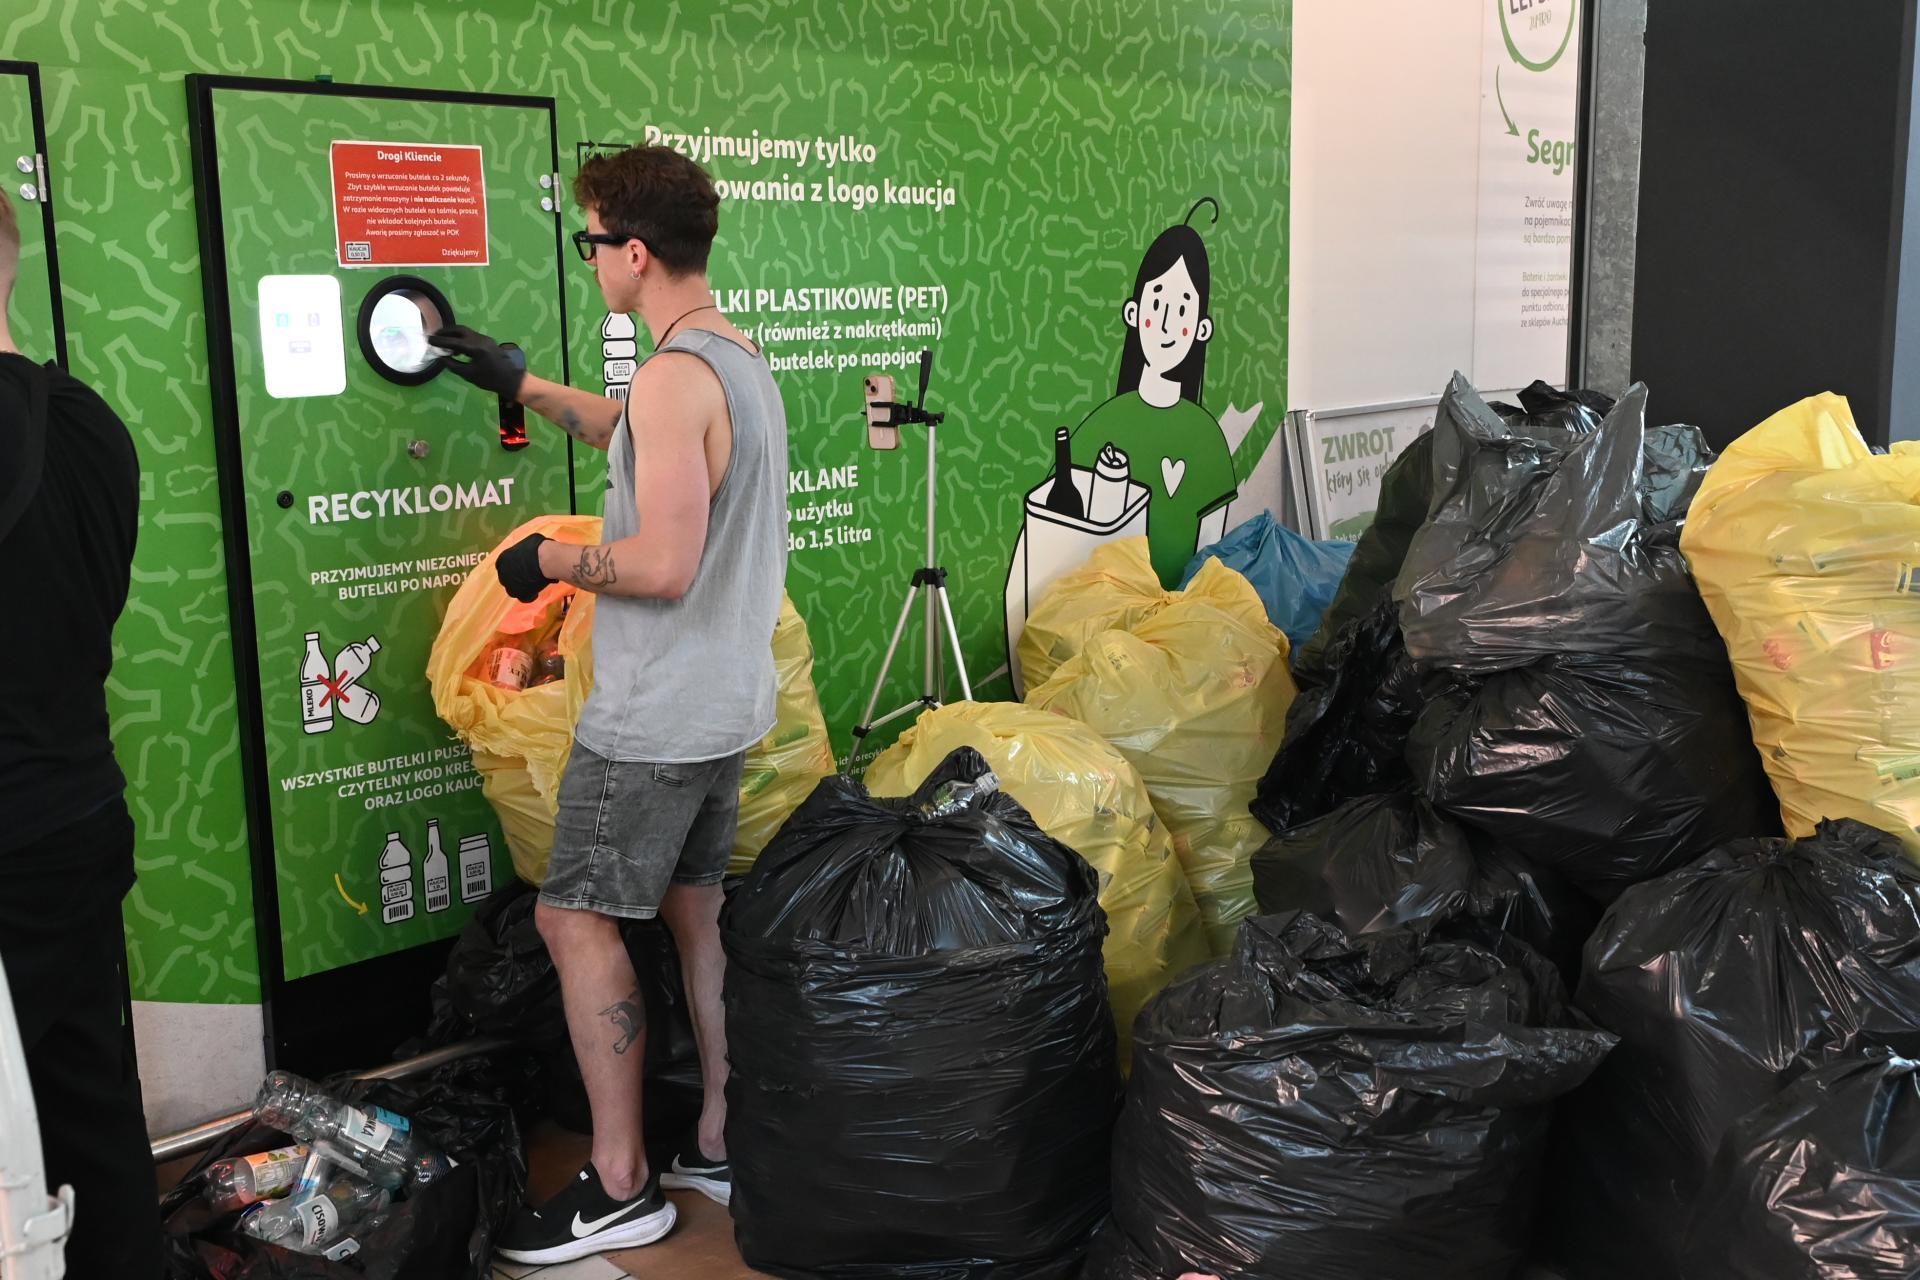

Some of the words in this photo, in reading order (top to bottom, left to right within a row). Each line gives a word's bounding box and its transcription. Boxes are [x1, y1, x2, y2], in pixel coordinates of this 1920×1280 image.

[377, 150, 403, 163] Drogi
[404, 151, 442, 162] Kliencie
[645, 125, 810, 168] Przyjmujemy
[815, 135, 876, 168] tylko
[345, 172, 370, 181] Prosimy
[408, 173, 431, 181] butelek
[347, 183, 362, 192] Zbyt
[363, 183, 386, 192] szybkie
[418, 184, 441, 192] butelek
[343, 195, 382, 204] zatrzymanie
[382, 196, 410, 204] maszyny
[712, 173, 805, 202] owania
[811, 183, 823, 202] z
[828, 176, 879, 211] logo
[884, 178, 956, 213] kaucja
[367, 207, 404, 215] widocznych
[404, 207, 427, 215] butelek
[404, 218, 433, 226] kolejnych
[366, 229, 388, 237] Awarię
[388, 229, 412, 237] prosimy
[442, 248, 480, 257] Dziękujemy
[709, 288, 750, 313] LKI
[755, 287, 893, 312] PLASTIKOWE
[897, 284, 948, 316] (PET)
[757, 320, 830, 347] (również
[833, 327, 842, 339] z
[845, 316, 942, 342] nakrętkami)
[770, 349, 834, 371] butelek
[838, 353, 858, 373] po
[861, 345, 928, 371] napojac
[1321, 426, 1396, 465] ZWROT
[786, 465, 858, 494] KLANE
[1325, 468, 1353, 502] który
[1357, 465, 1370, 487] się
[308, 477, 515, 524] RECYKLOMAT
[796, 498, 853, 525] użytku
[786, 532, 806, 552] do
[809, 528, 834, 551] 1,5
[837, 525, 872, 545] litra
[310, 560, 413, 586] PRZYJMUJEMY
[338, 580, 398, 601] BUTELKI
[400, 578, 420, 593] PO
[305, 688, 315, 718] MLEKO
[280, 763, 365, 792] WSZYSTKIE
[367, 752, 425, 775] BUTELKI
[427, 751, 433, 763] I
[338, 772, 411, 799] CZYTELNY
[414, 766, 442, 784] KOD
[364, 791, 403, 811] ORAZ
[405, 783, 443, 802] LOGO
